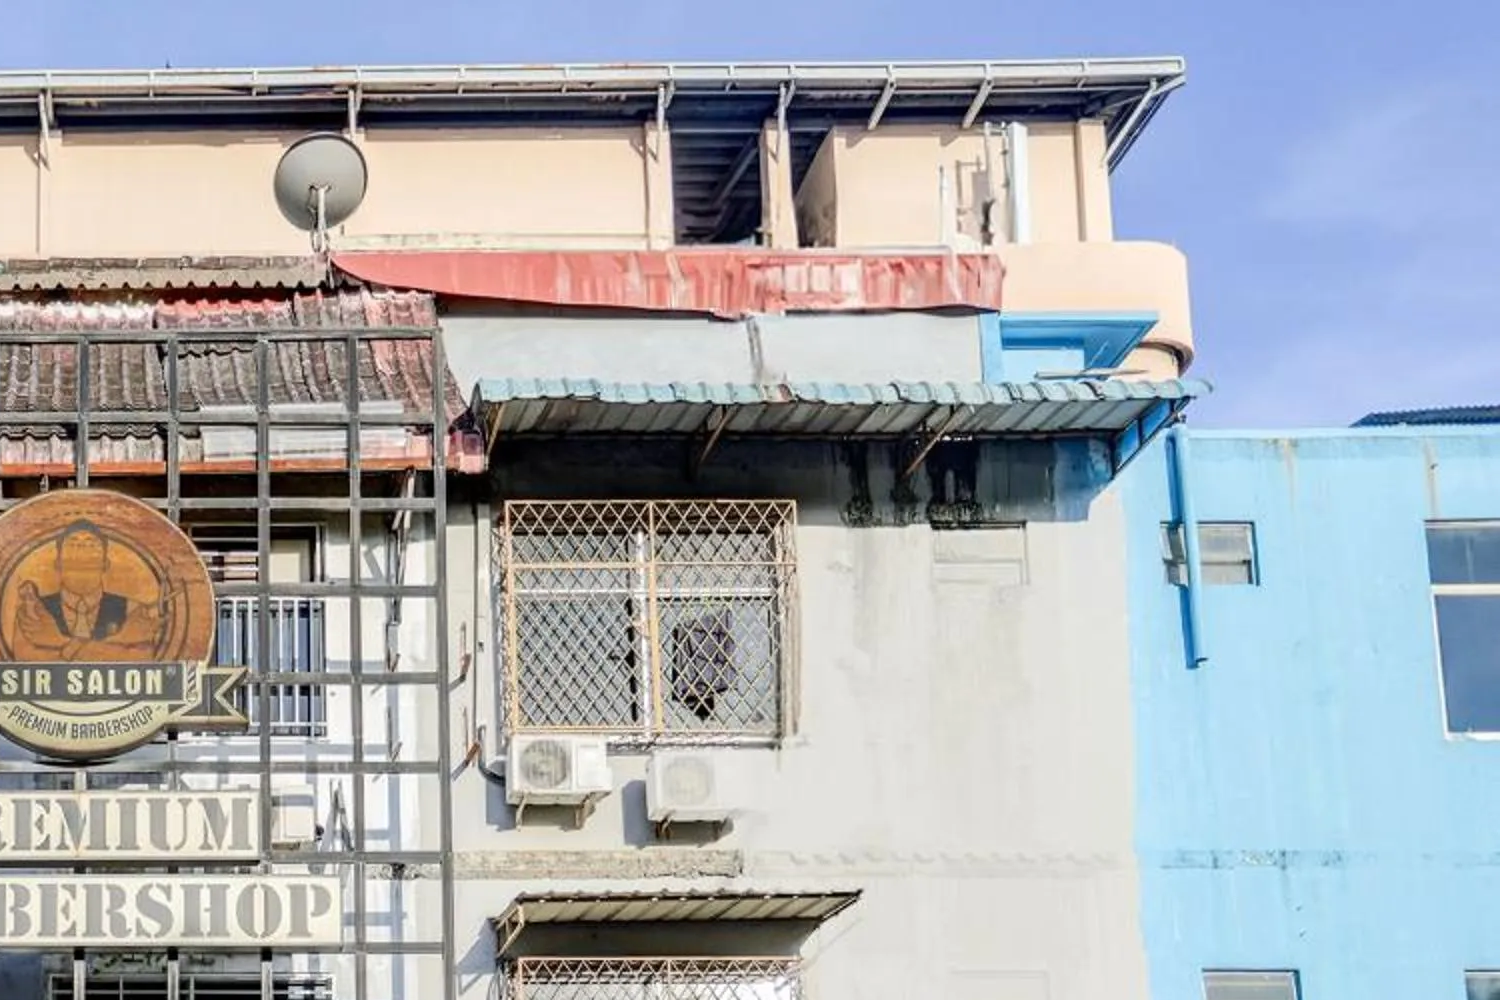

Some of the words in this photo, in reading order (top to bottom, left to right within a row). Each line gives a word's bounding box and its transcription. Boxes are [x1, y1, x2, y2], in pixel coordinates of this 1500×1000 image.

[1, 669, 52, 695] SIR
[67, 669, 163, 695] SALON
[7, 704, 68, 740] PREMIUM
[71, 704, 155, 740] BARBERSHOP
